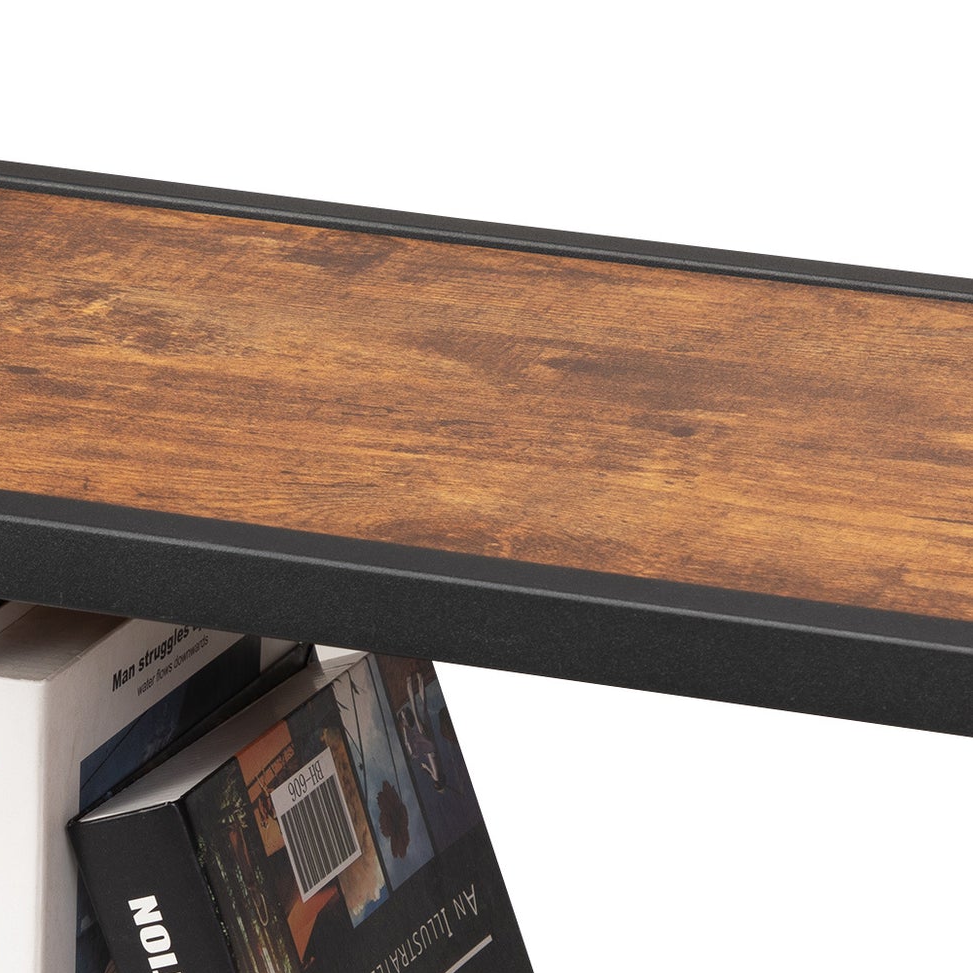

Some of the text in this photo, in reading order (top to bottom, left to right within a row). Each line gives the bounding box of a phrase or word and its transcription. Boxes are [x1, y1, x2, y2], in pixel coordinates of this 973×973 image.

[112, 625, 189, 692] Man struggles
[137, 634, 209, 696] water flows downwards
[287, 760, 325, 802] BH-606
